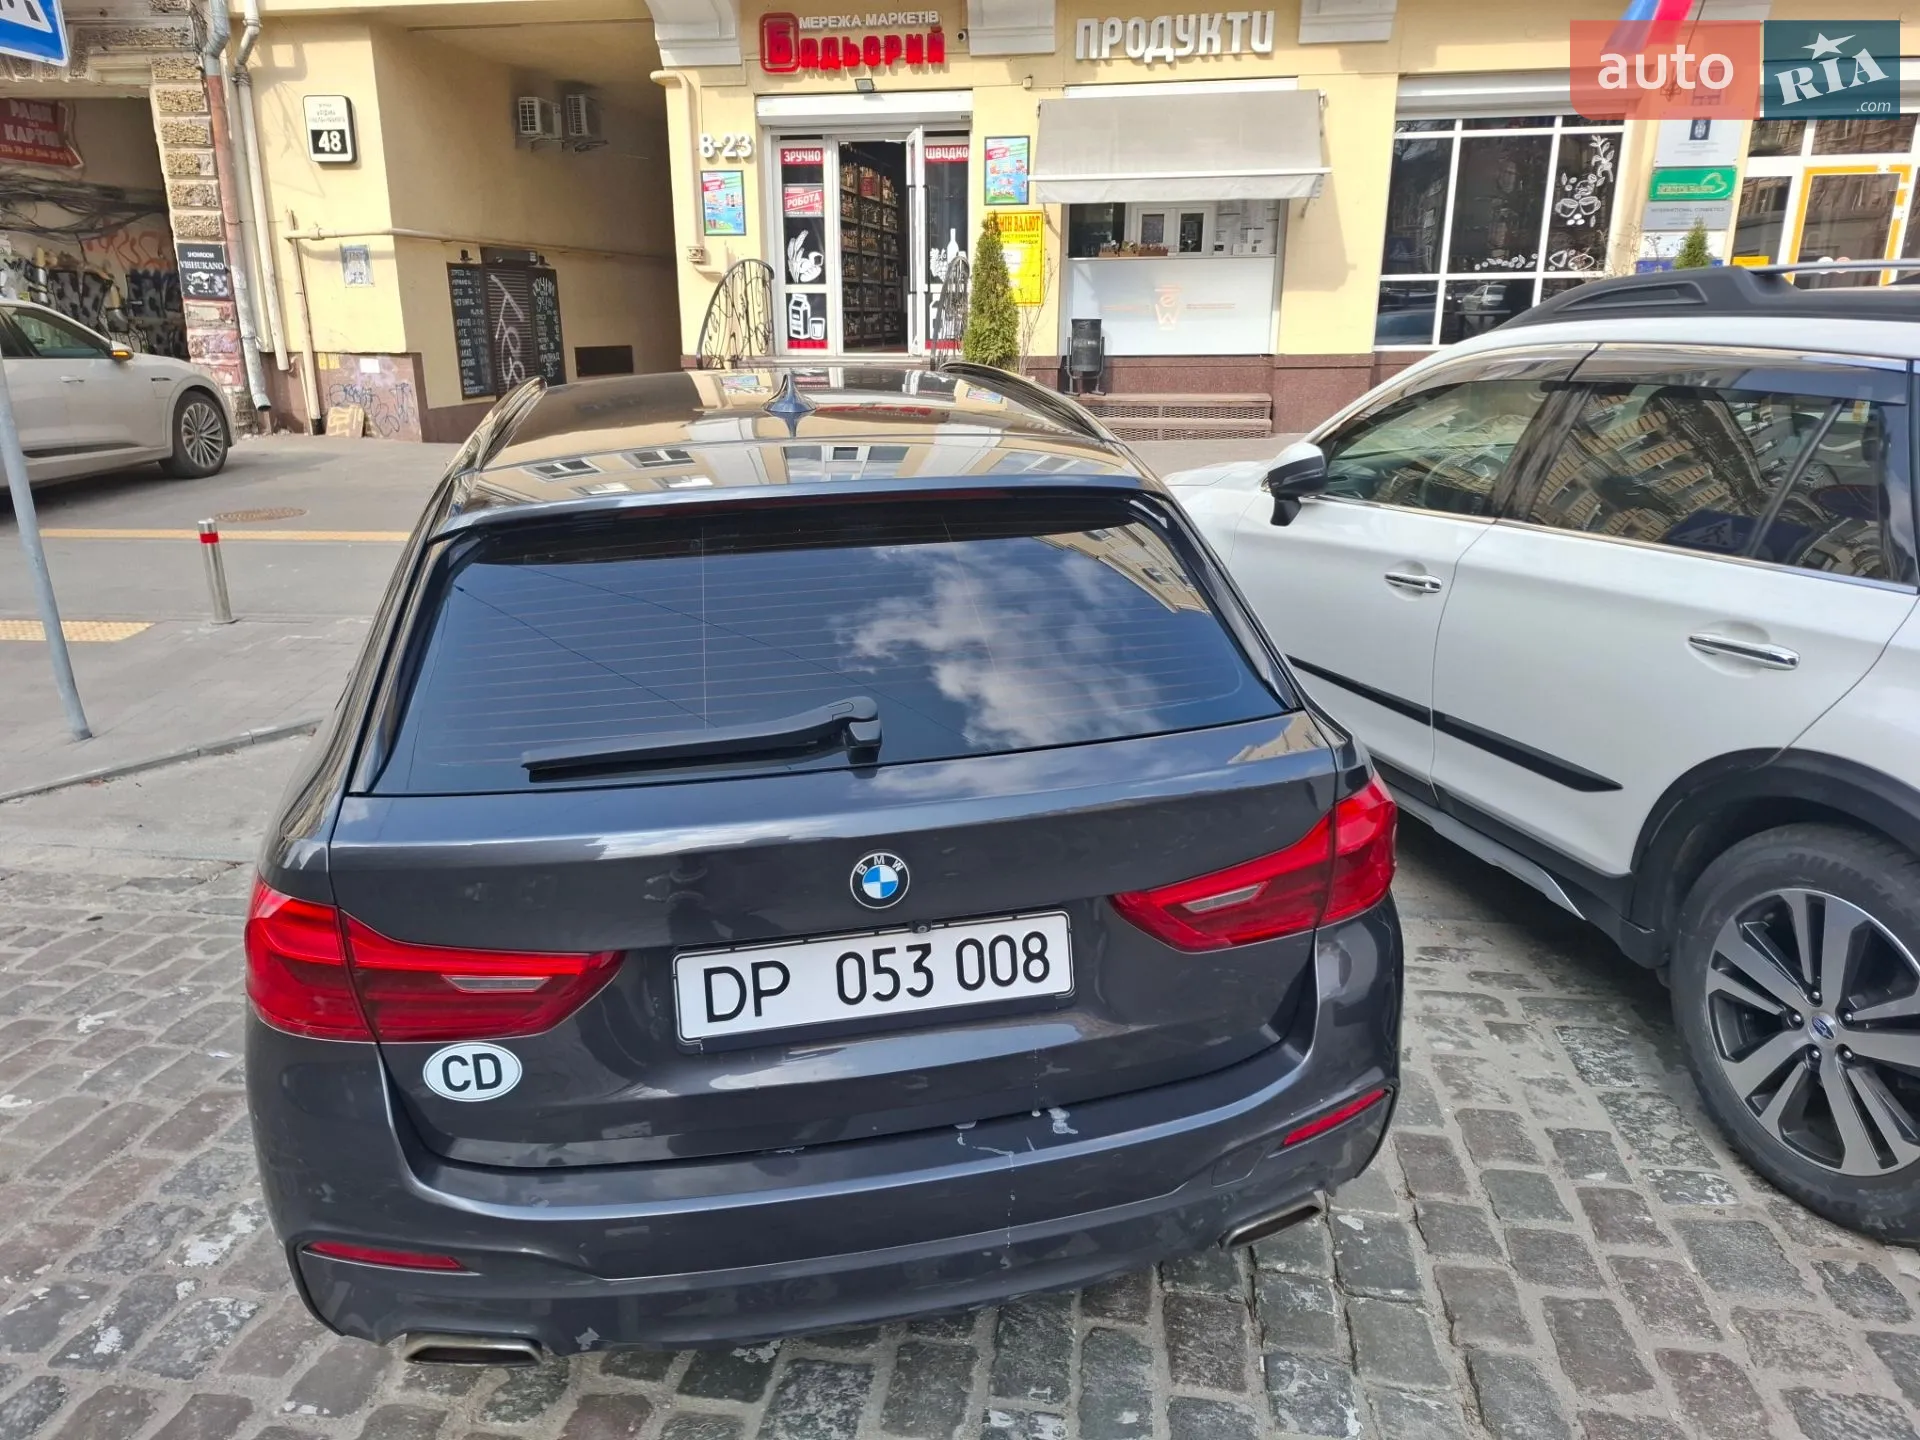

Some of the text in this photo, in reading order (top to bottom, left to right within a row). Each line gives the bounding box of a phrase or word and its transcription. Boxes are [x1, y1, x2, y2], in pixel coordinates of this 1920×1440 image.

[799, 11, 939, 29] МЕРЕЖА МАРКЕТІВ
[1075, 11, 1275, 63] ПРОДУКТИ
[318, 130, 342, 152] 48
[699, 134, 752, 158] 8-23
[783, 150, 821, 162] ЗРУЧНО
[925, 147, 968, 160] ШВИДКО
[786, 192, 821, 208] РОБОТА
[857, 855, 904, 875] BMW
[703, 931, 1051, 1023] DP 053 008
[442, 1053, 503, 1093] CD
